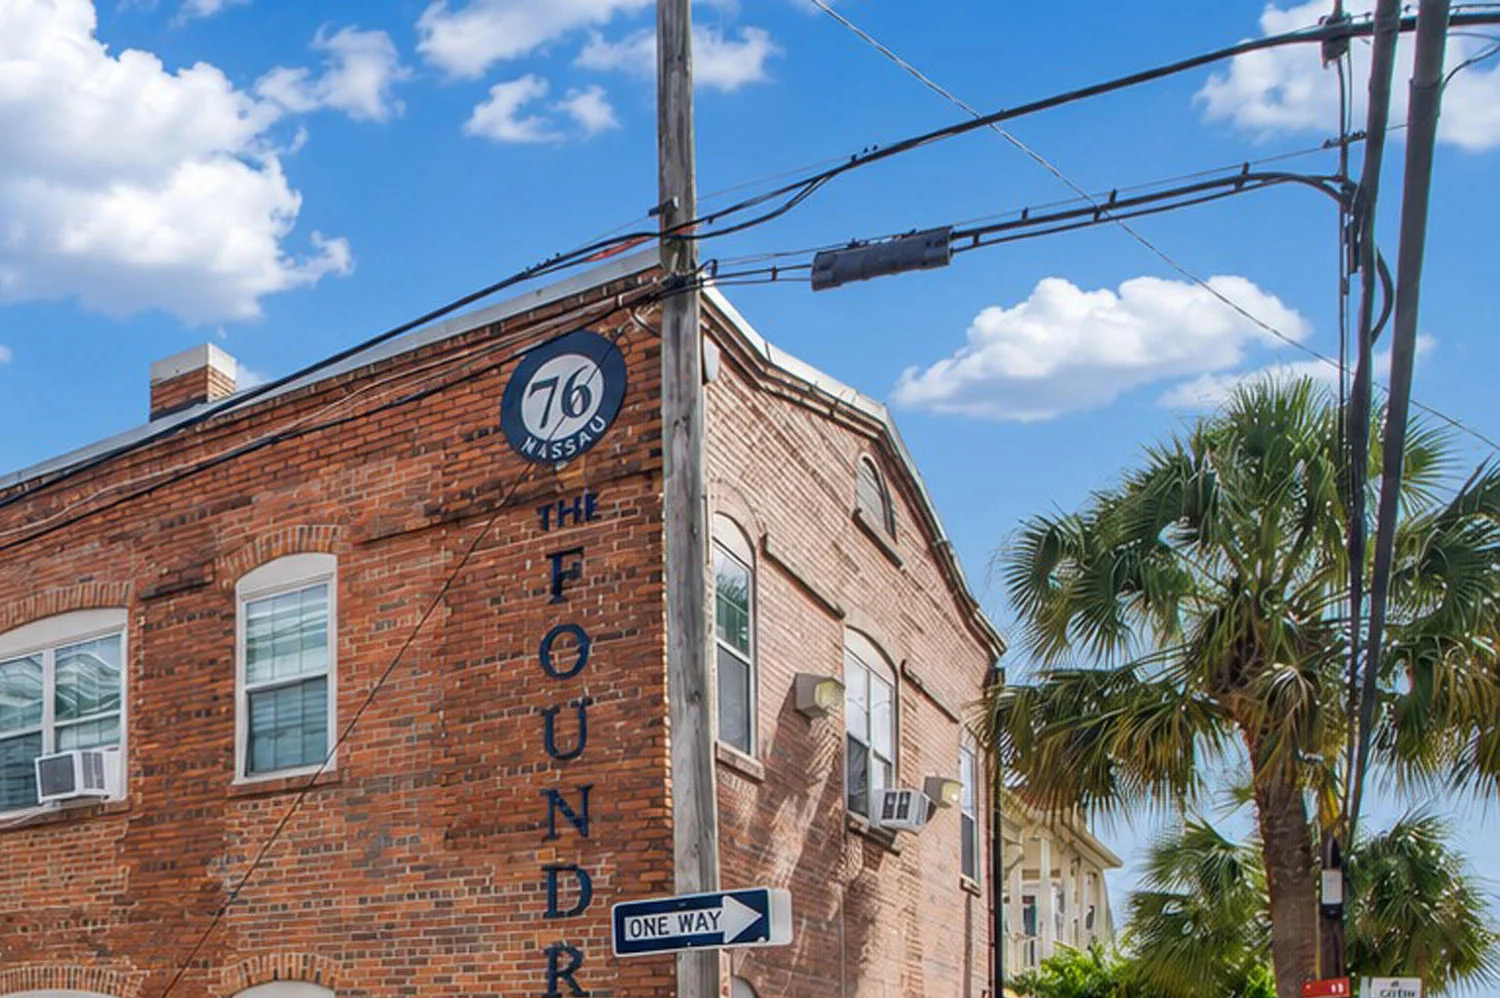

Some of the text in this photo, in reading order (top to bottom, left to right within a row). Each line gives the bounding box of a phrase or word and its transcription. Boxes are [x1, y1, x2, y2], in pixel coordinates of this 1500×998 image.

[529, 364, 592, 430] 76
[521, 415, 607, 460] NASSAU
[537, 493, 601, 532] THE
[630, 911, 722, 938] ONE WAY
